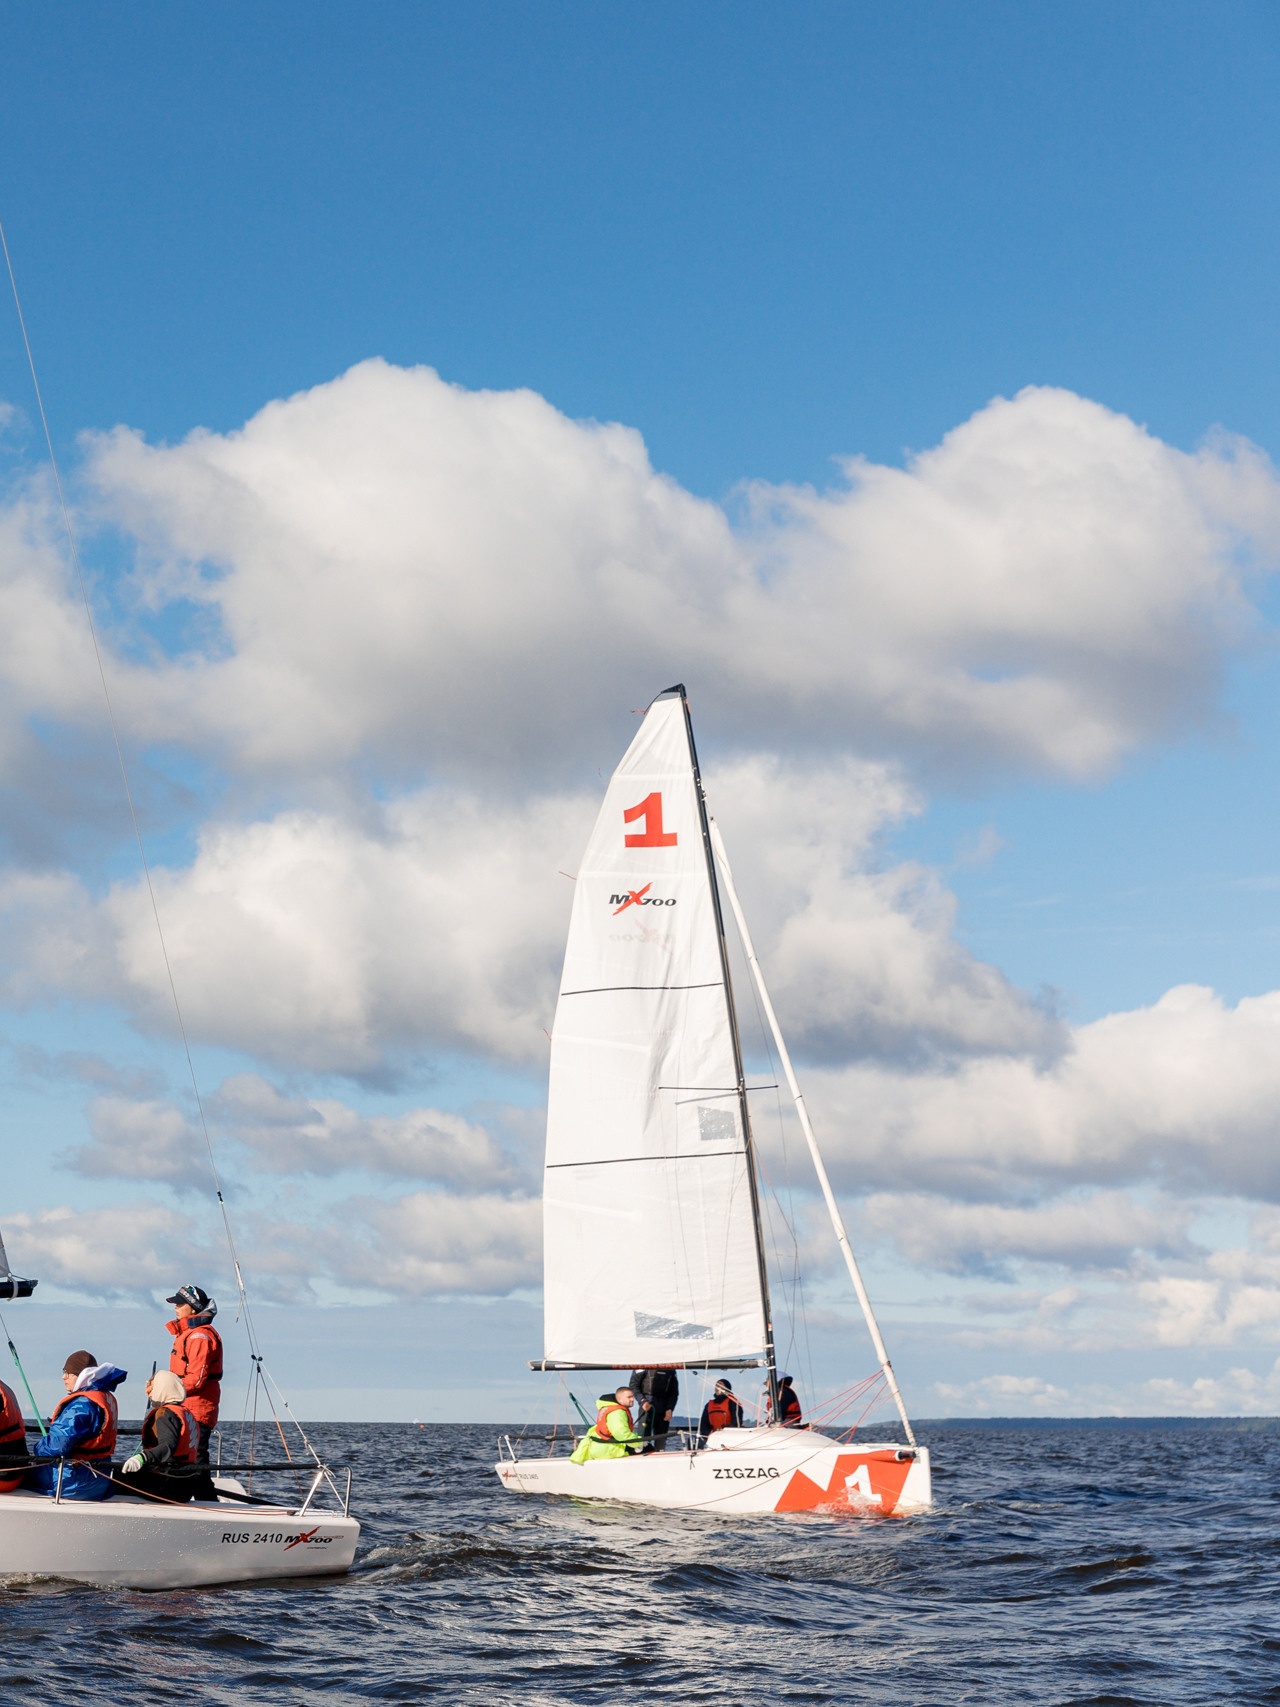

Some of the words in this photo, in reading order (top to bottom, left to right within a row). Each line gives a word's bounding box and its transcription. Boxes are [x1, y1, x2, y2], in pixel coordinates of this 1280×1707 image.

[623, 792, 678, 848] 1
[608, 881, 677, 916] MX700
[712, 1467, 781, 1480] ZIGZAG
[844, 1464, 883, 1504] 1
[221, 1533, 251, 1544] RUS
[253, 1533, 283, 1544] 2410
[284, 1526, 333, 1551] MX700
